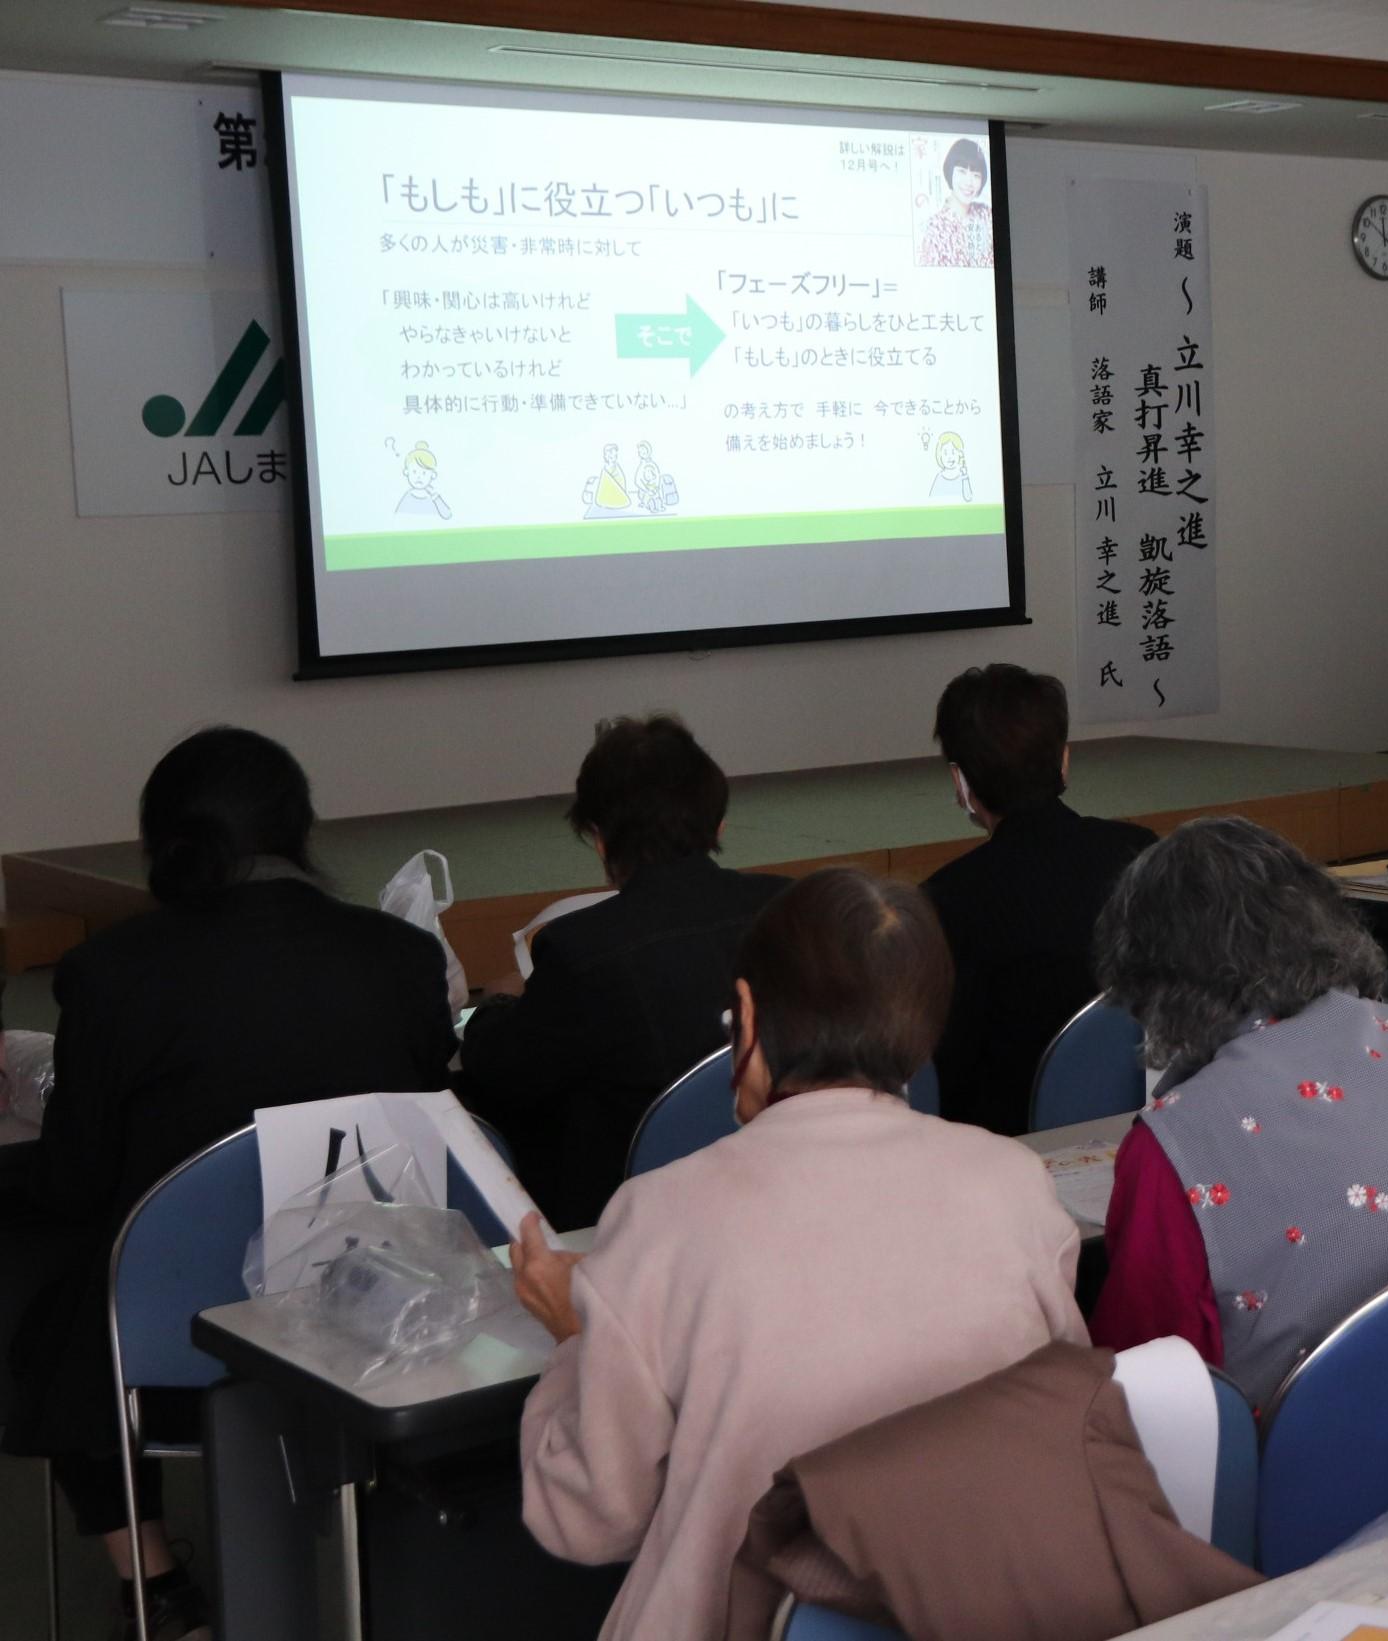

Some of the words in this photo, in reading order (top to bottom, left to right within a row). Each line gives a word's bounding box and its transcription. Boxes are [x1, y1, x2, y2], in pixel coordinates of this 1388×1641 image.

[213, 111, 257, 171] 第
[382, 173, 800, 224] 「もしも」に役立つ「いつも」に
[379, 232, 642, 257] 多くの人が災害・非常時に対して
[1173, 210, 1195, 260] 演題
[382, 289, 592, 311] 「興味・関心は高いけれど
[1087, 264, 1107, 316] 講師
[732, 309, 985, 333] 「いつも」の暮らしをひと工夫して
[399, 323, 573, 345] やらなきゃいけないと
[637, 324, 693, 349] そこで
[400, 358, 564, 380] わかっているけれど
[734, 346, 937, 368] 「もしも」のときに役立てる
[1089, 355, 1115, 434] 落語家
[1133, 363, 1173, 497] 真打昇進
